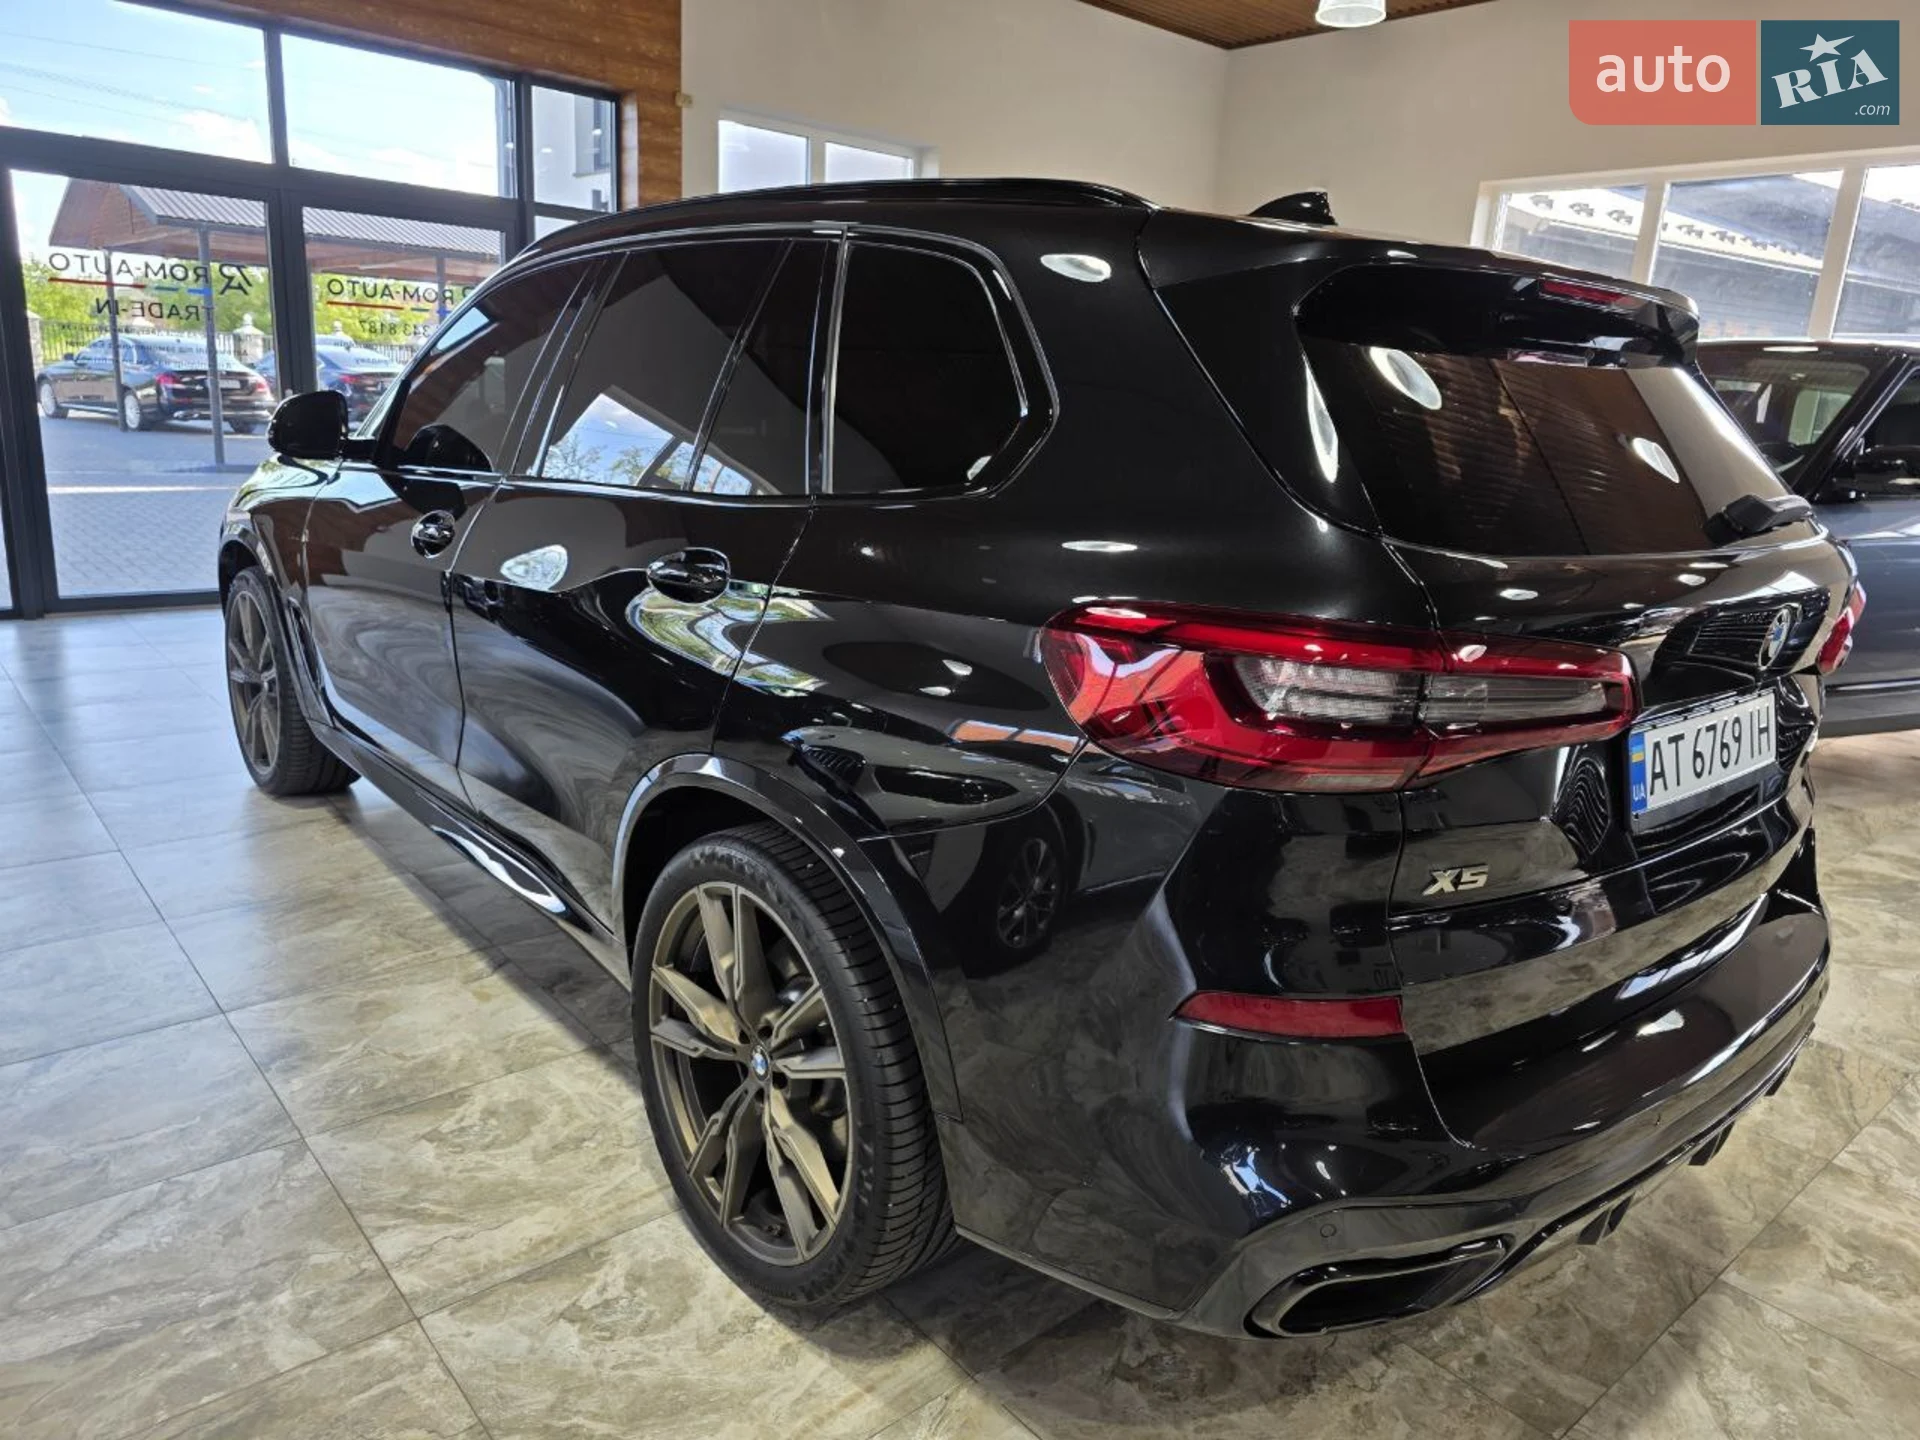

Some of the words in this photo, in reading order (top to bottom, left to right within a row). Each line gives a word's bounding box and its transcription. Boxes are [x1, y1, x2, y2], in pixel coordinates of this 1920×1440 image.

[1650, 732, 1685, 796] AT
[1692, 716, 1742, 779] 6769
[1750, 703, 1771, 759] IH
[1632, 784, 1646, 801] UA
[1422, 863, 1489, 897] X5
